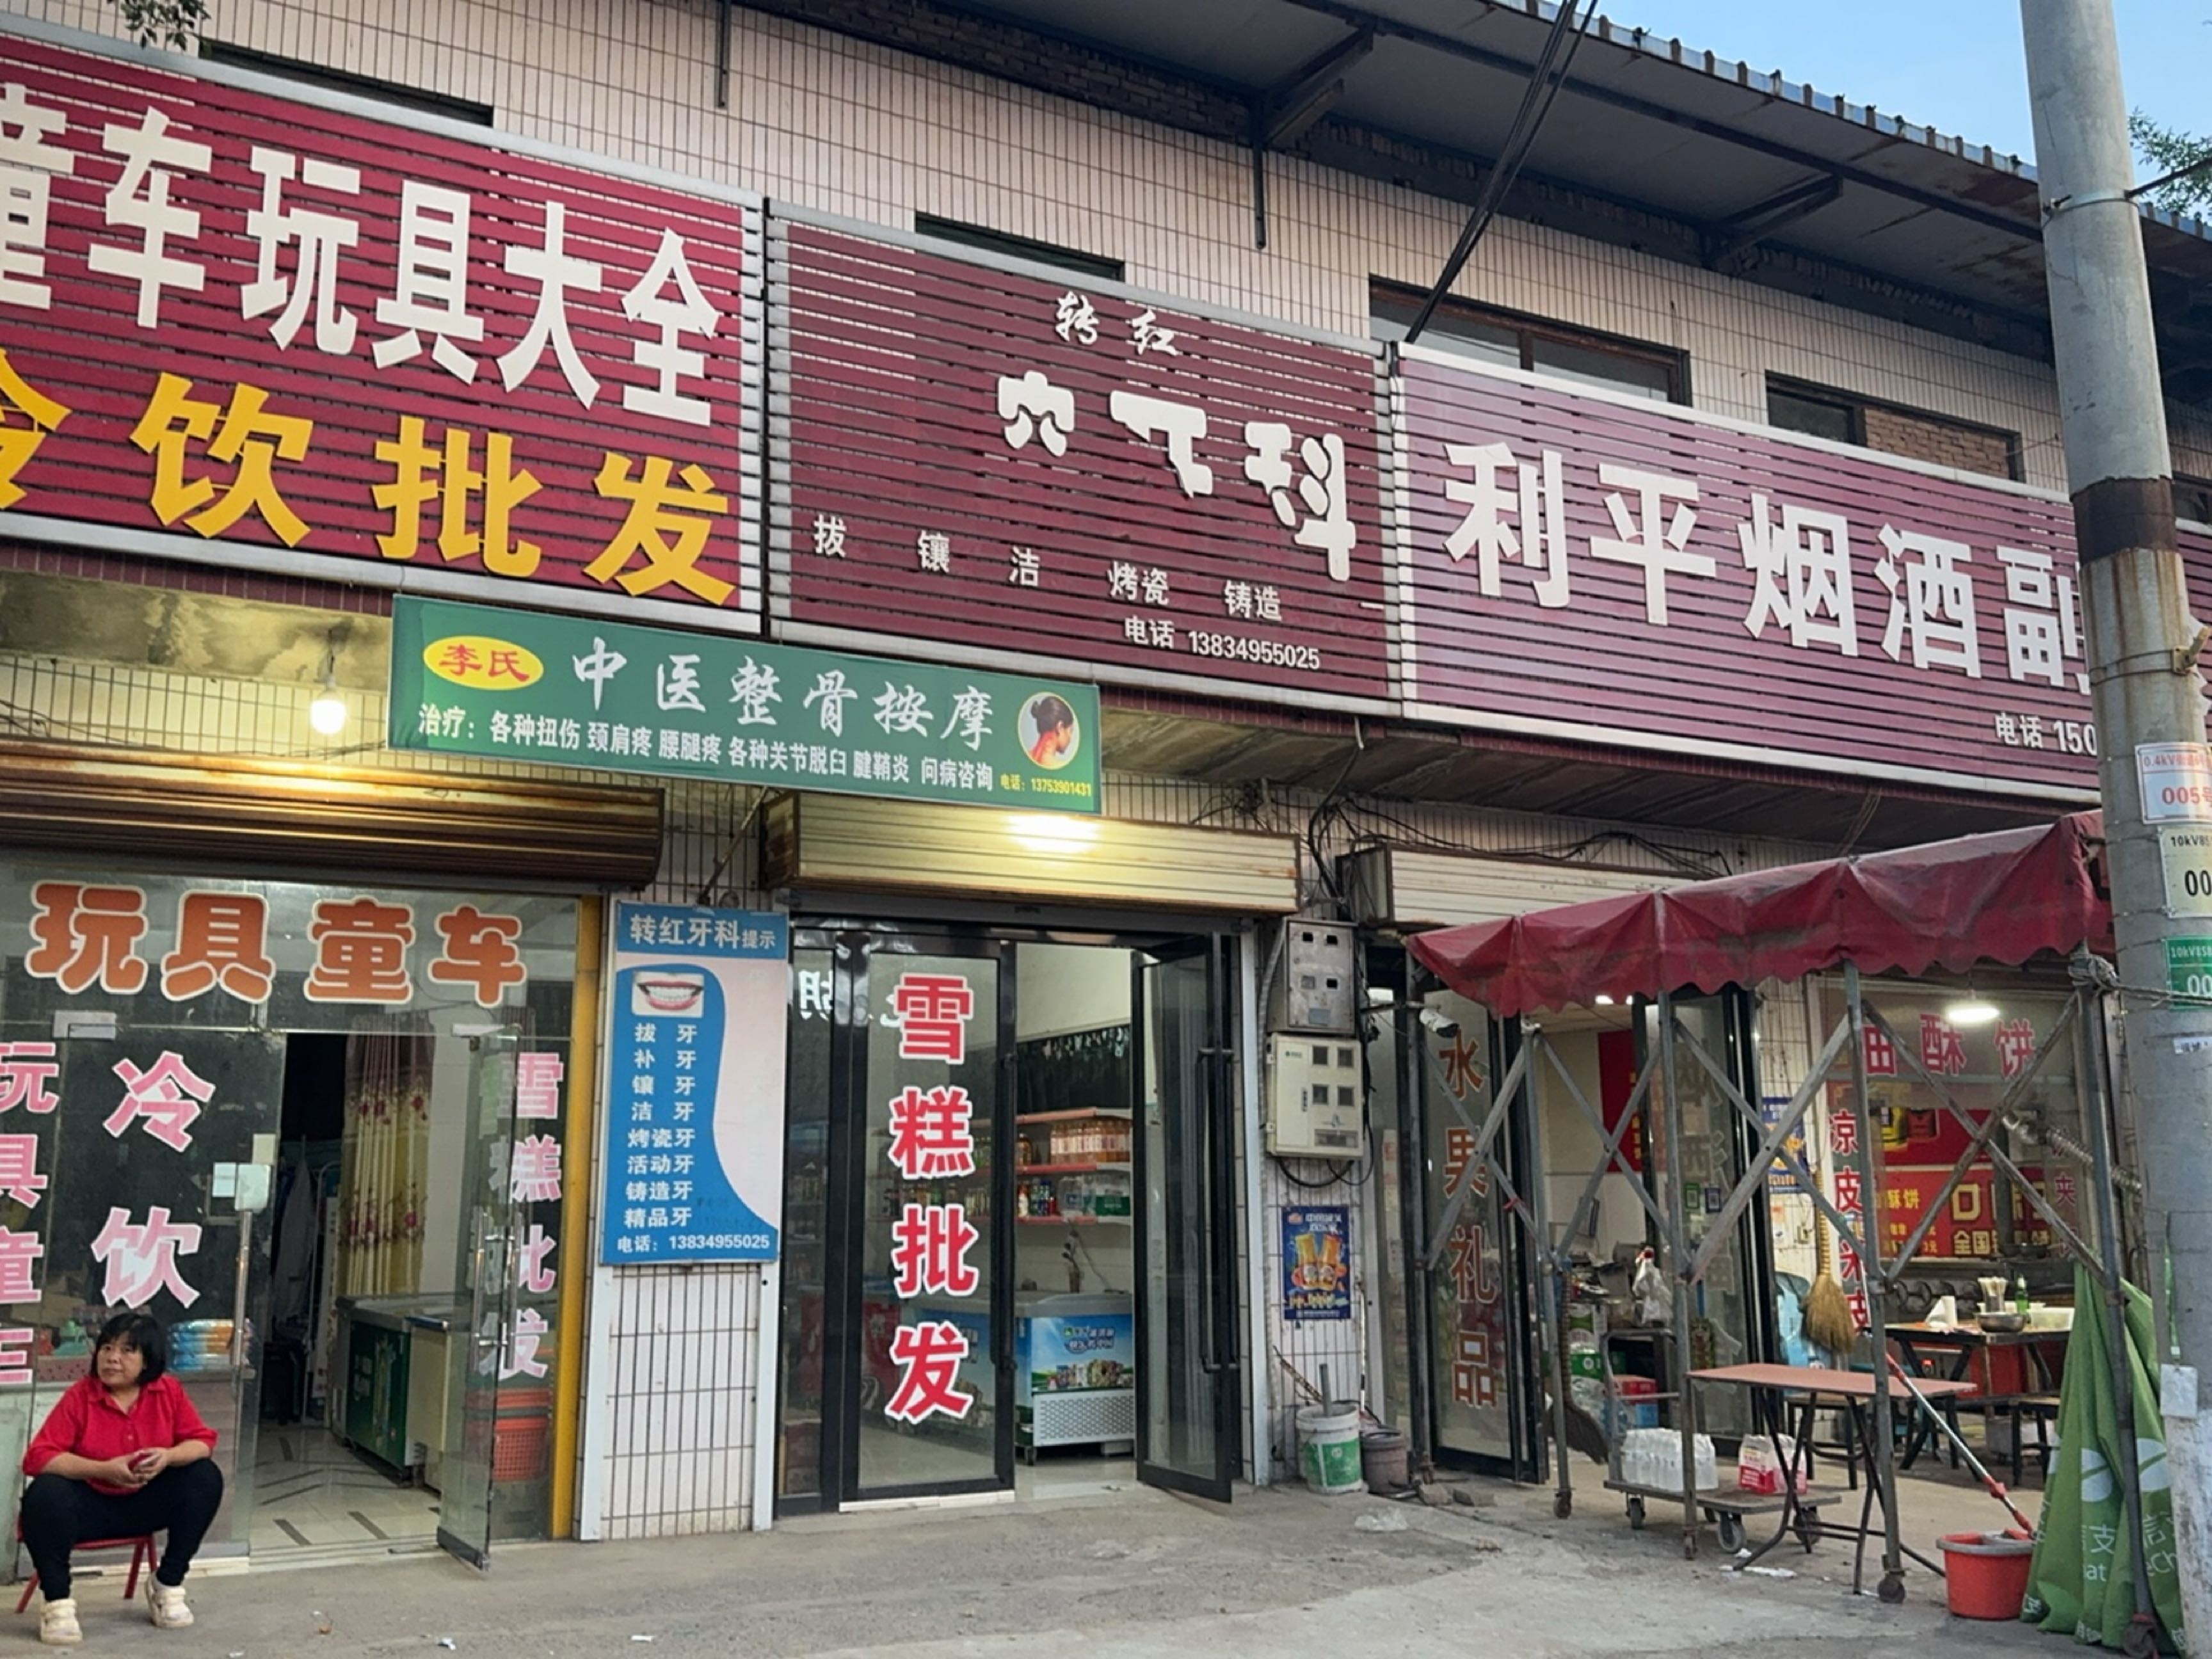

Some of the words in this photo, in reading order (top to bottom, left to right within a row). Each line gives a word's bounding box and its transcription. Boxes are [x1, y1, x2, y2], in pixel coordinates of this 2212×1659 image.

[814, 515, 847, 558] 拔
[918, 530, 950, 573] 镶
[1009, 547, 1040, 588] 洁
[1107, 561, 1170, 605] 烤瓷
[1224, 580, 1283, 623] 铸造
[1445, 443, 2211, 715] 利平烟酒副
[1124, 616, 1174, 650] 电话
[1188, 631, 1320, 669] 13834955025
[438, 644, 531, 682] 李氏
[572, 636, 993, 751] 中医整骨按摩
[490, 710, 581, 749] 各种扭伤
[1994, 712, 2044, 750] 电话
[26, 879, 527, 1008] 玩具童车
[627, 1127, 696, 1149] 烤瓷牙
[627, 1154, 694, 1175] 活动牙
[91, 1050, 216, 1310] 冷饮
[625, 1180, 693, 1202] 铸造牙
[885, 972, 979, 1424] 雪糕批发
[623, 1206, 692, 1228] 精品牙
[669, 1233, 770, 1250] 13834955025
[1439, 1028, 1498, 1407] 水果礼品
